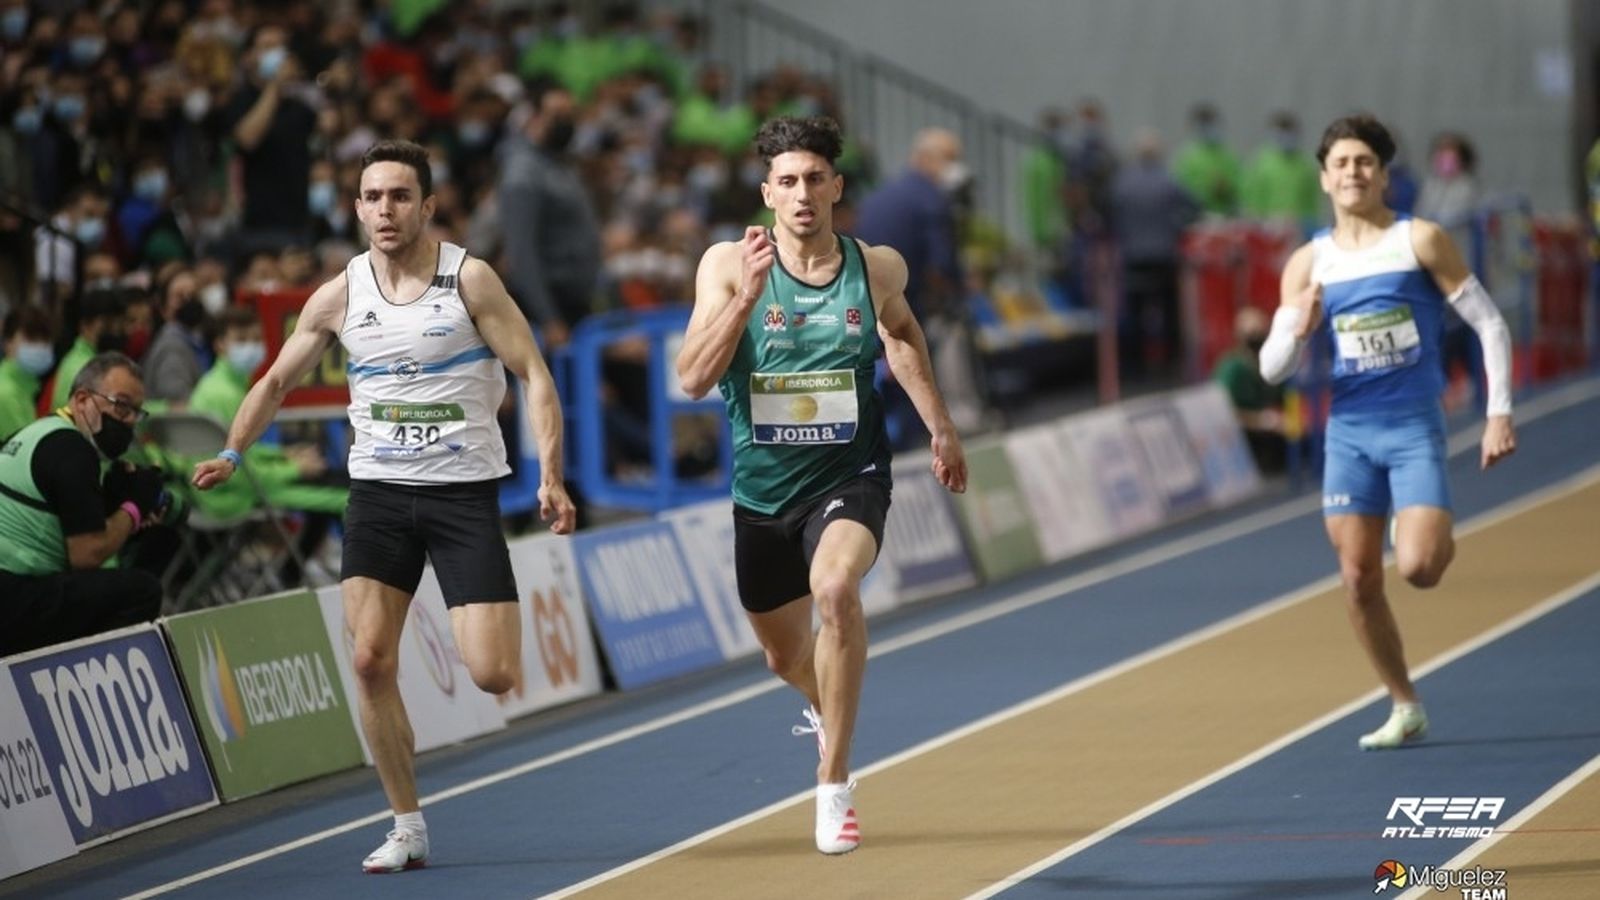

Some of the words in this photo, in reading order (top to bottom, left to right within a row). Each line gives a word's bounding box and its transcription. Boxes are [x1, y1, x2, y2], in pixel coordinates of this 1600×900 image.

[1358, 331, 1394, 353] 161
[785, 377, 842, 389] IBERDROLA
[399, 408, 452, 419] IBERDROLA
[393, 425, 440, 446] 430
[234, 652, 338, 726] IBERDROLA
